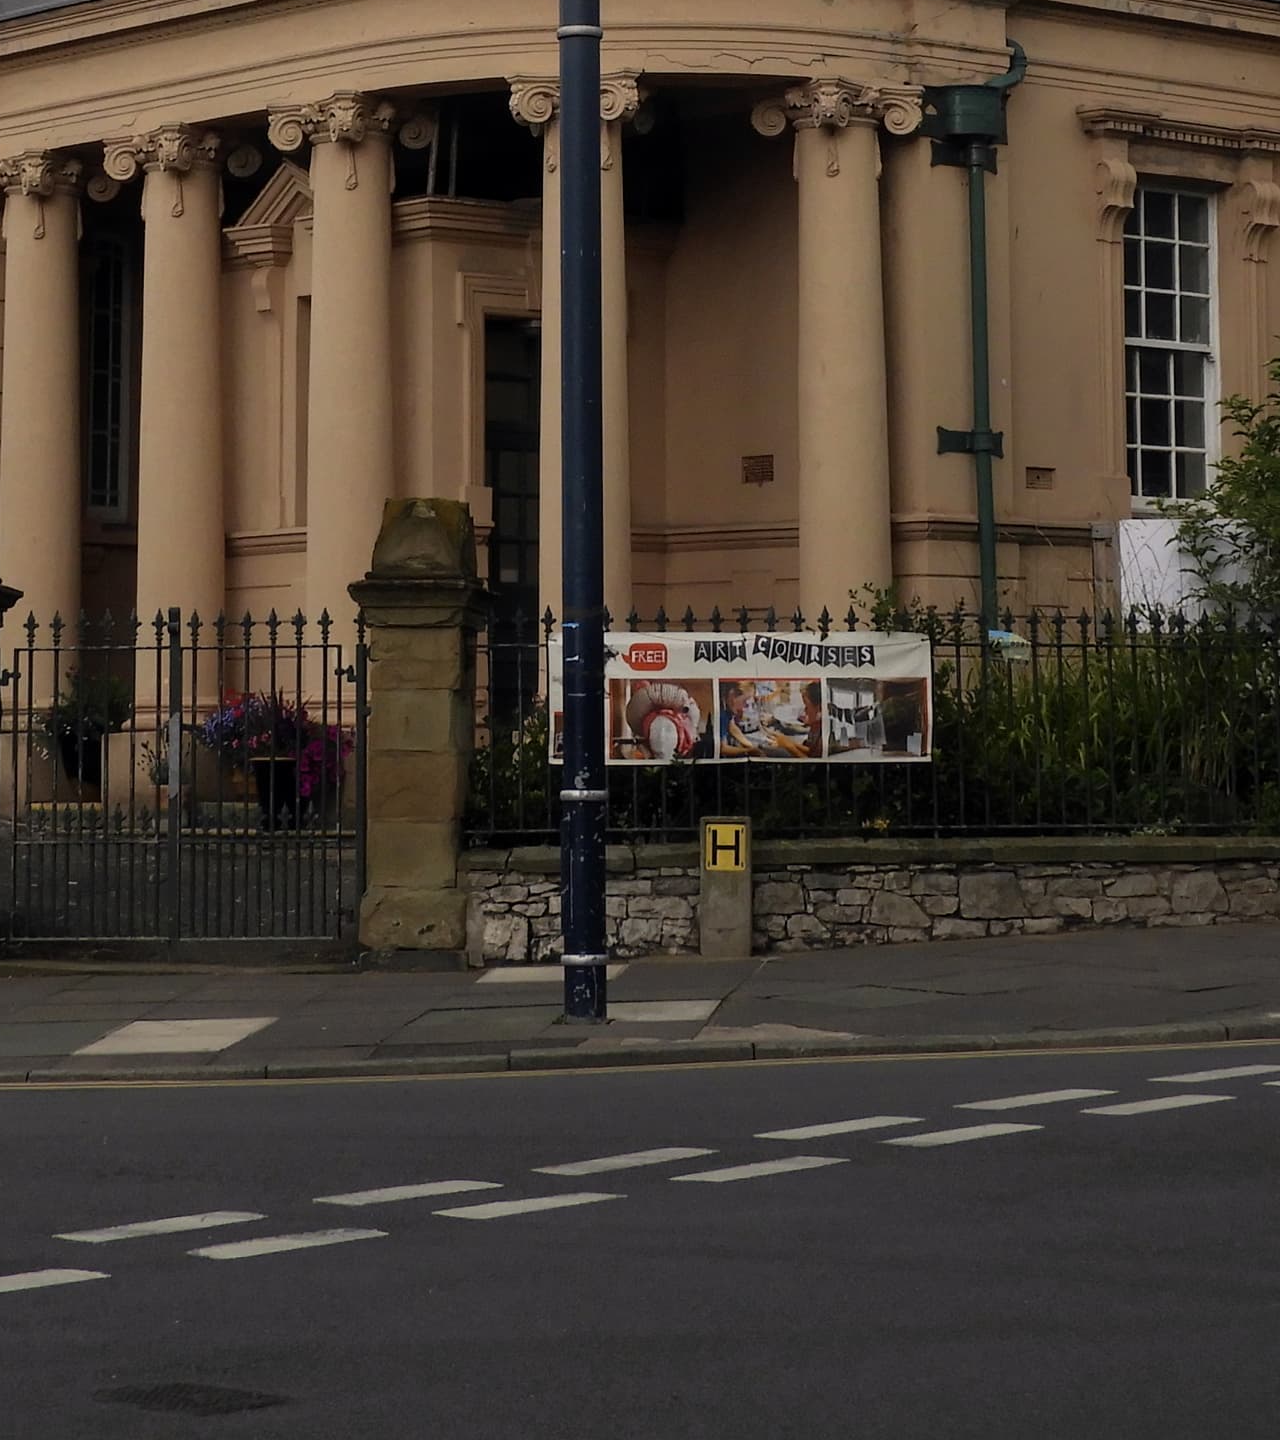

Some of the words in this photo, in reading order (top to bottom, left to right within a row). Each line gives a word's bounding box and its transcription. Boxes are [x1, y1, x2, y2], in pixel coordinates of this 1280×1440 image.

[631, 650, 666, 663] FREE!
[696, 641, 744, 657] ART
[758, 636, 871, 663] COURSES
[712, 830, 740, 866] H
